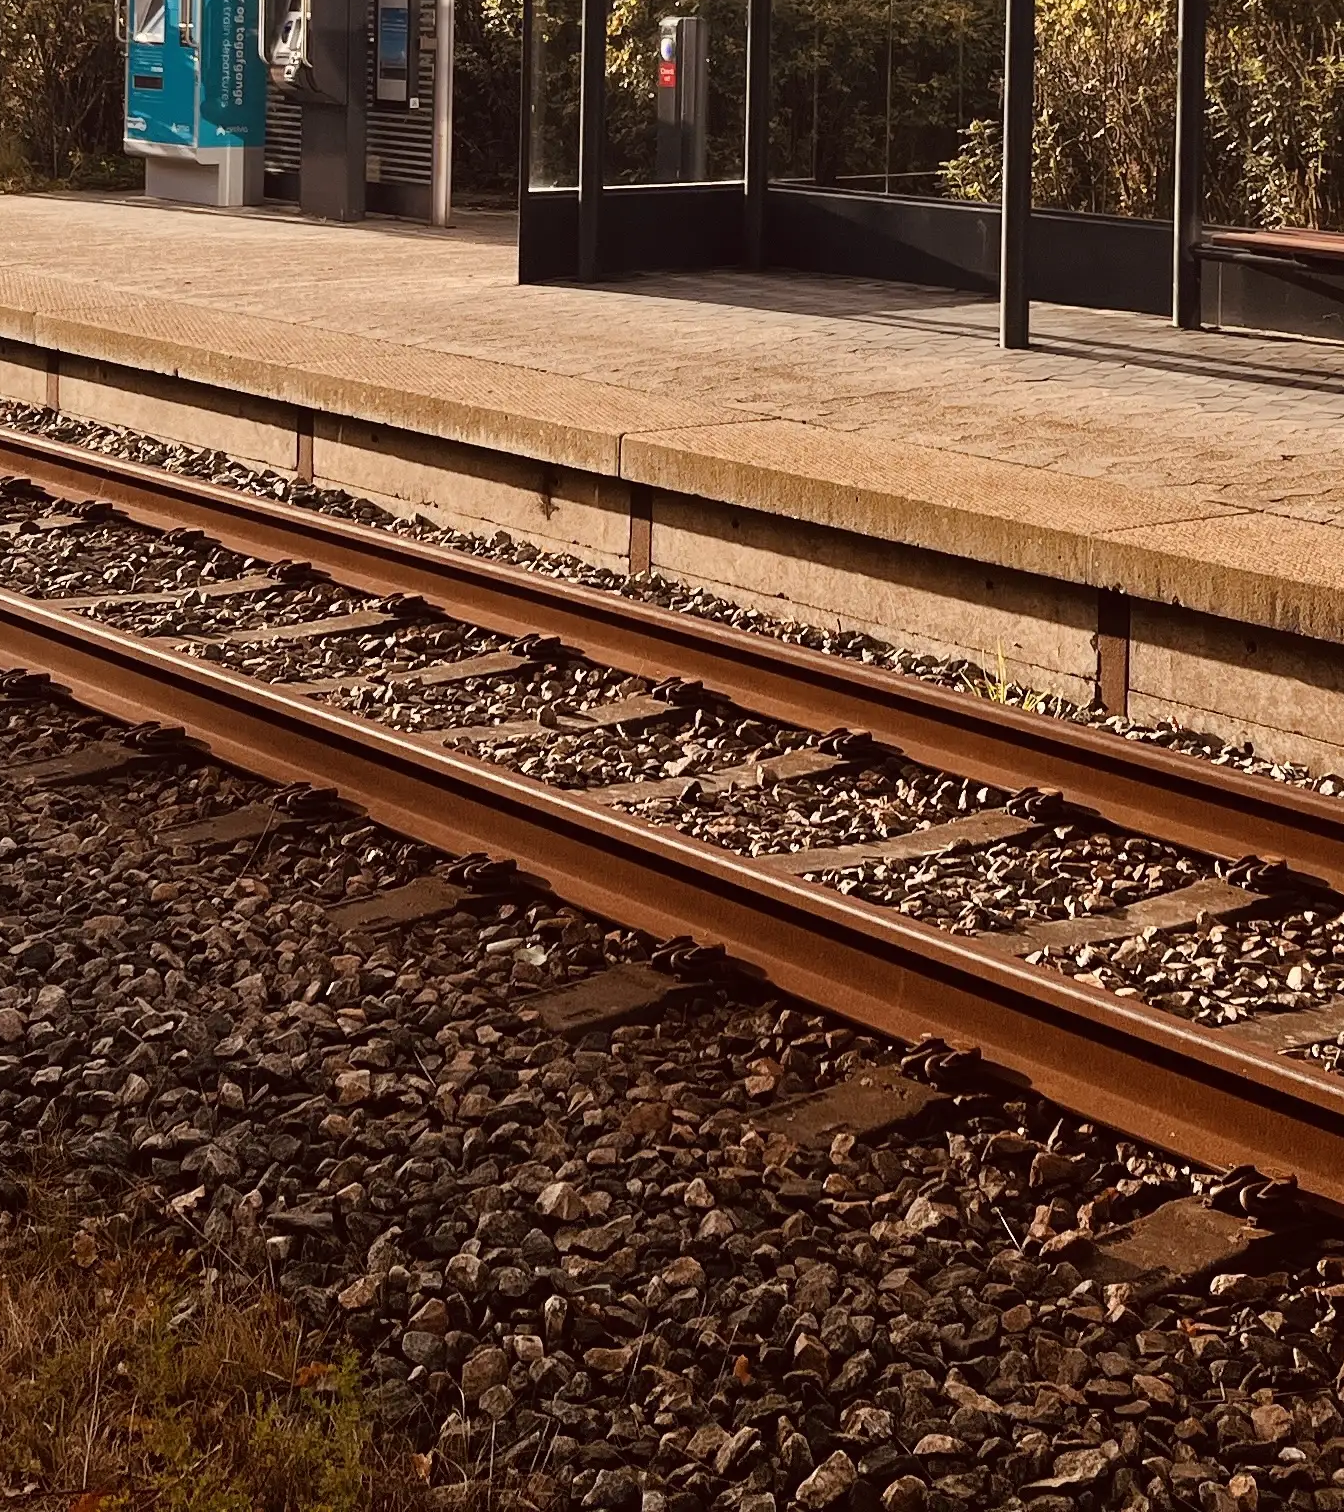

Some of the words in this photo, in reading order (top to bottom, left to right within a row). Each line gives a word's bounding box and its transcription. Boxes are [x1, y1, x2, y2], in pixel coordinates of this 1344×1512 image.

[222, 7, 233, 36] train
[234, 7, 245, 23] og
[220, 38, 233, 108] departures
[232, 27, 247, 106] togafgange
